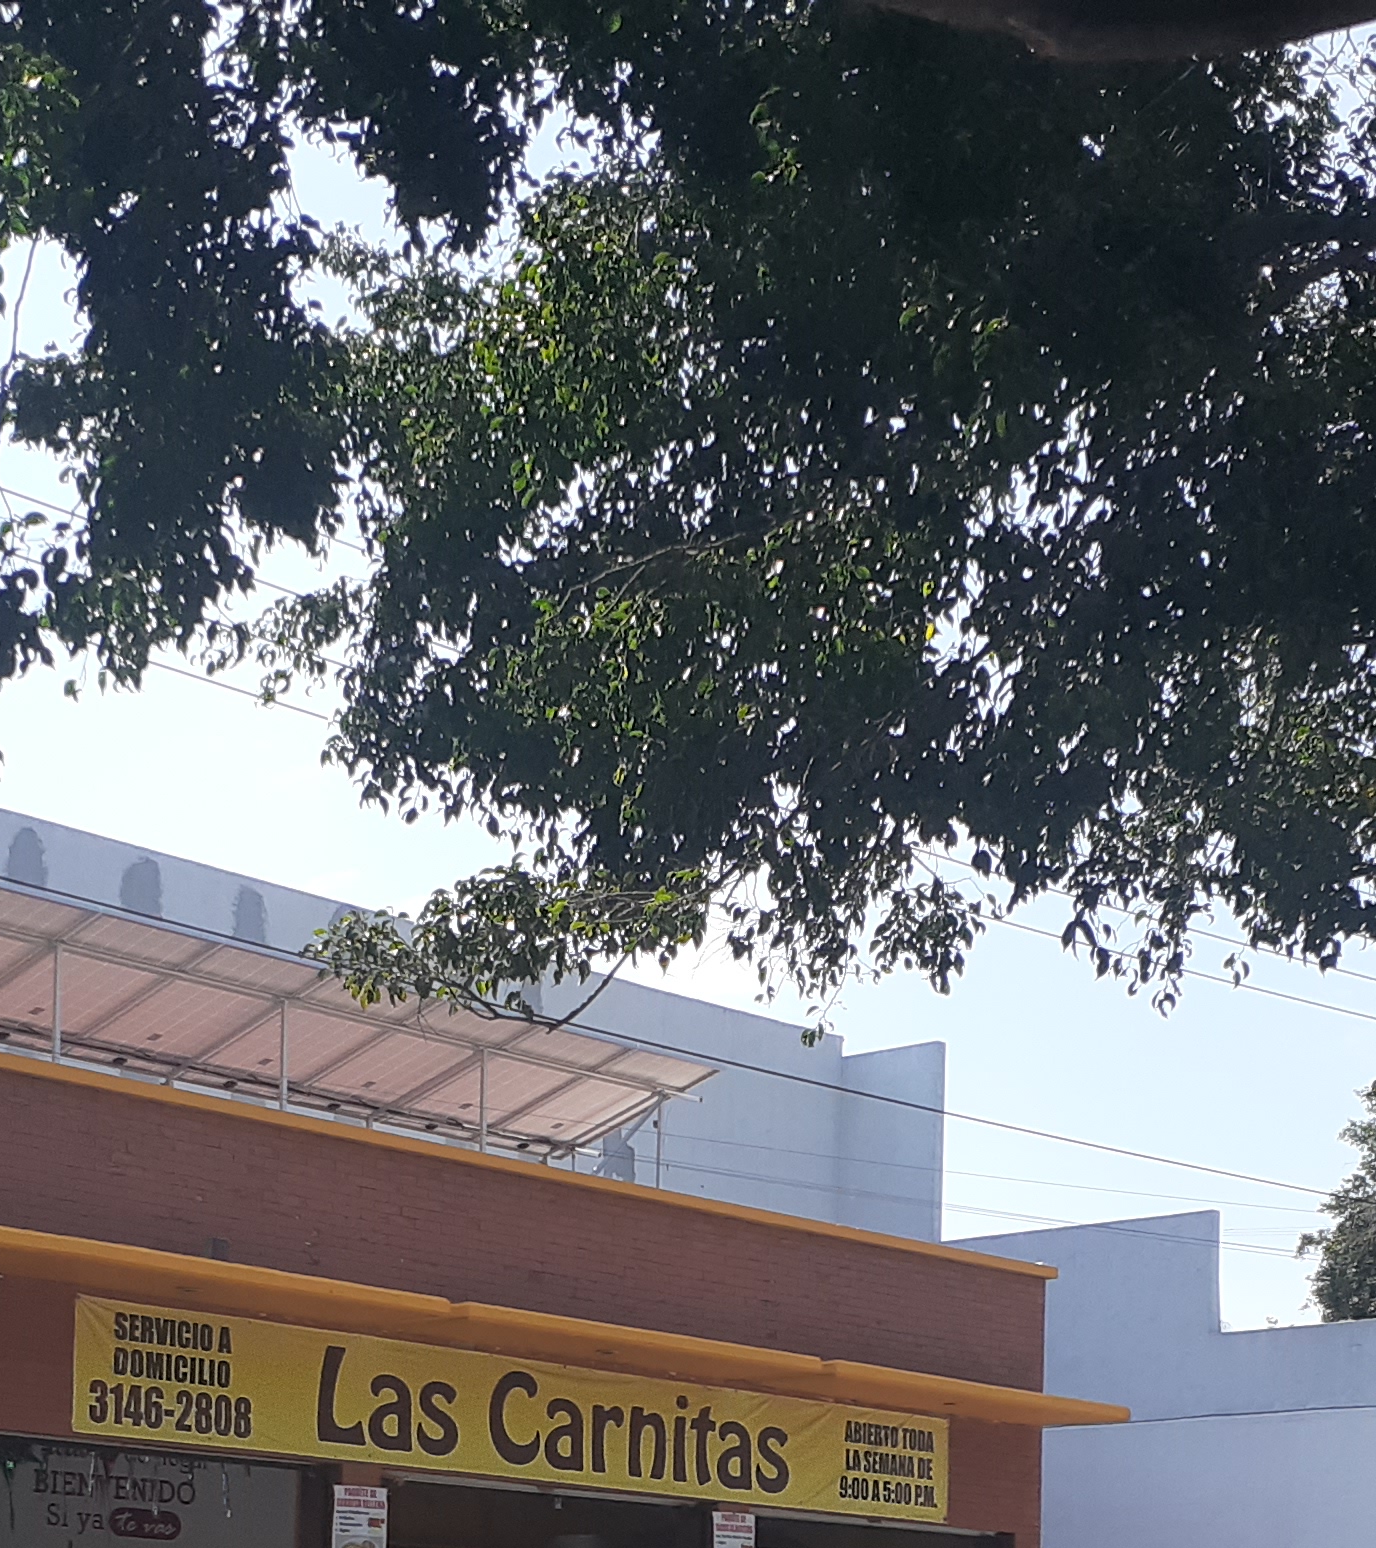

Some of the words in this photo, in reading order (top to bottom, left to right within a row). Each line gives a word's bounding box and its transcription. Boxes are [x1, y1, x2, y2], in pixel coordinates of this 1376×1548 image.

[113, 1311, 215, 1352] SERVICIO
[217, 1326, 233, 1355] A
[112, 1346, 232, 1389] DOMICILIO
[88, 1379, 253, 1439] 3146-2808
[316, 1345, 459, 1457] Las
[488, 1370, 791, 1494] Carnitas
[844, 1420, 899, 1449] ABIERTO
[901, 1427, 935, 1453] TODA
[845, 1448, 862, 1472] LA
[863, 1450, 916, 1479] SEMANA
[917, 1457, 934, 1480] DE
[33, 1468, 197, 1506] BIENVENIDO
[839, 1475, 869, 1501] 9:00
[871, 1480, 881, 1502] A
[882, 1481, 912, 1505] 5:00
[914, 1484, 939, 1508] P.M.
[76, 1511, 105, 1535] ya
[114, 1511, 137, 1532] te
[143, 1522, 177, 1536] vas
